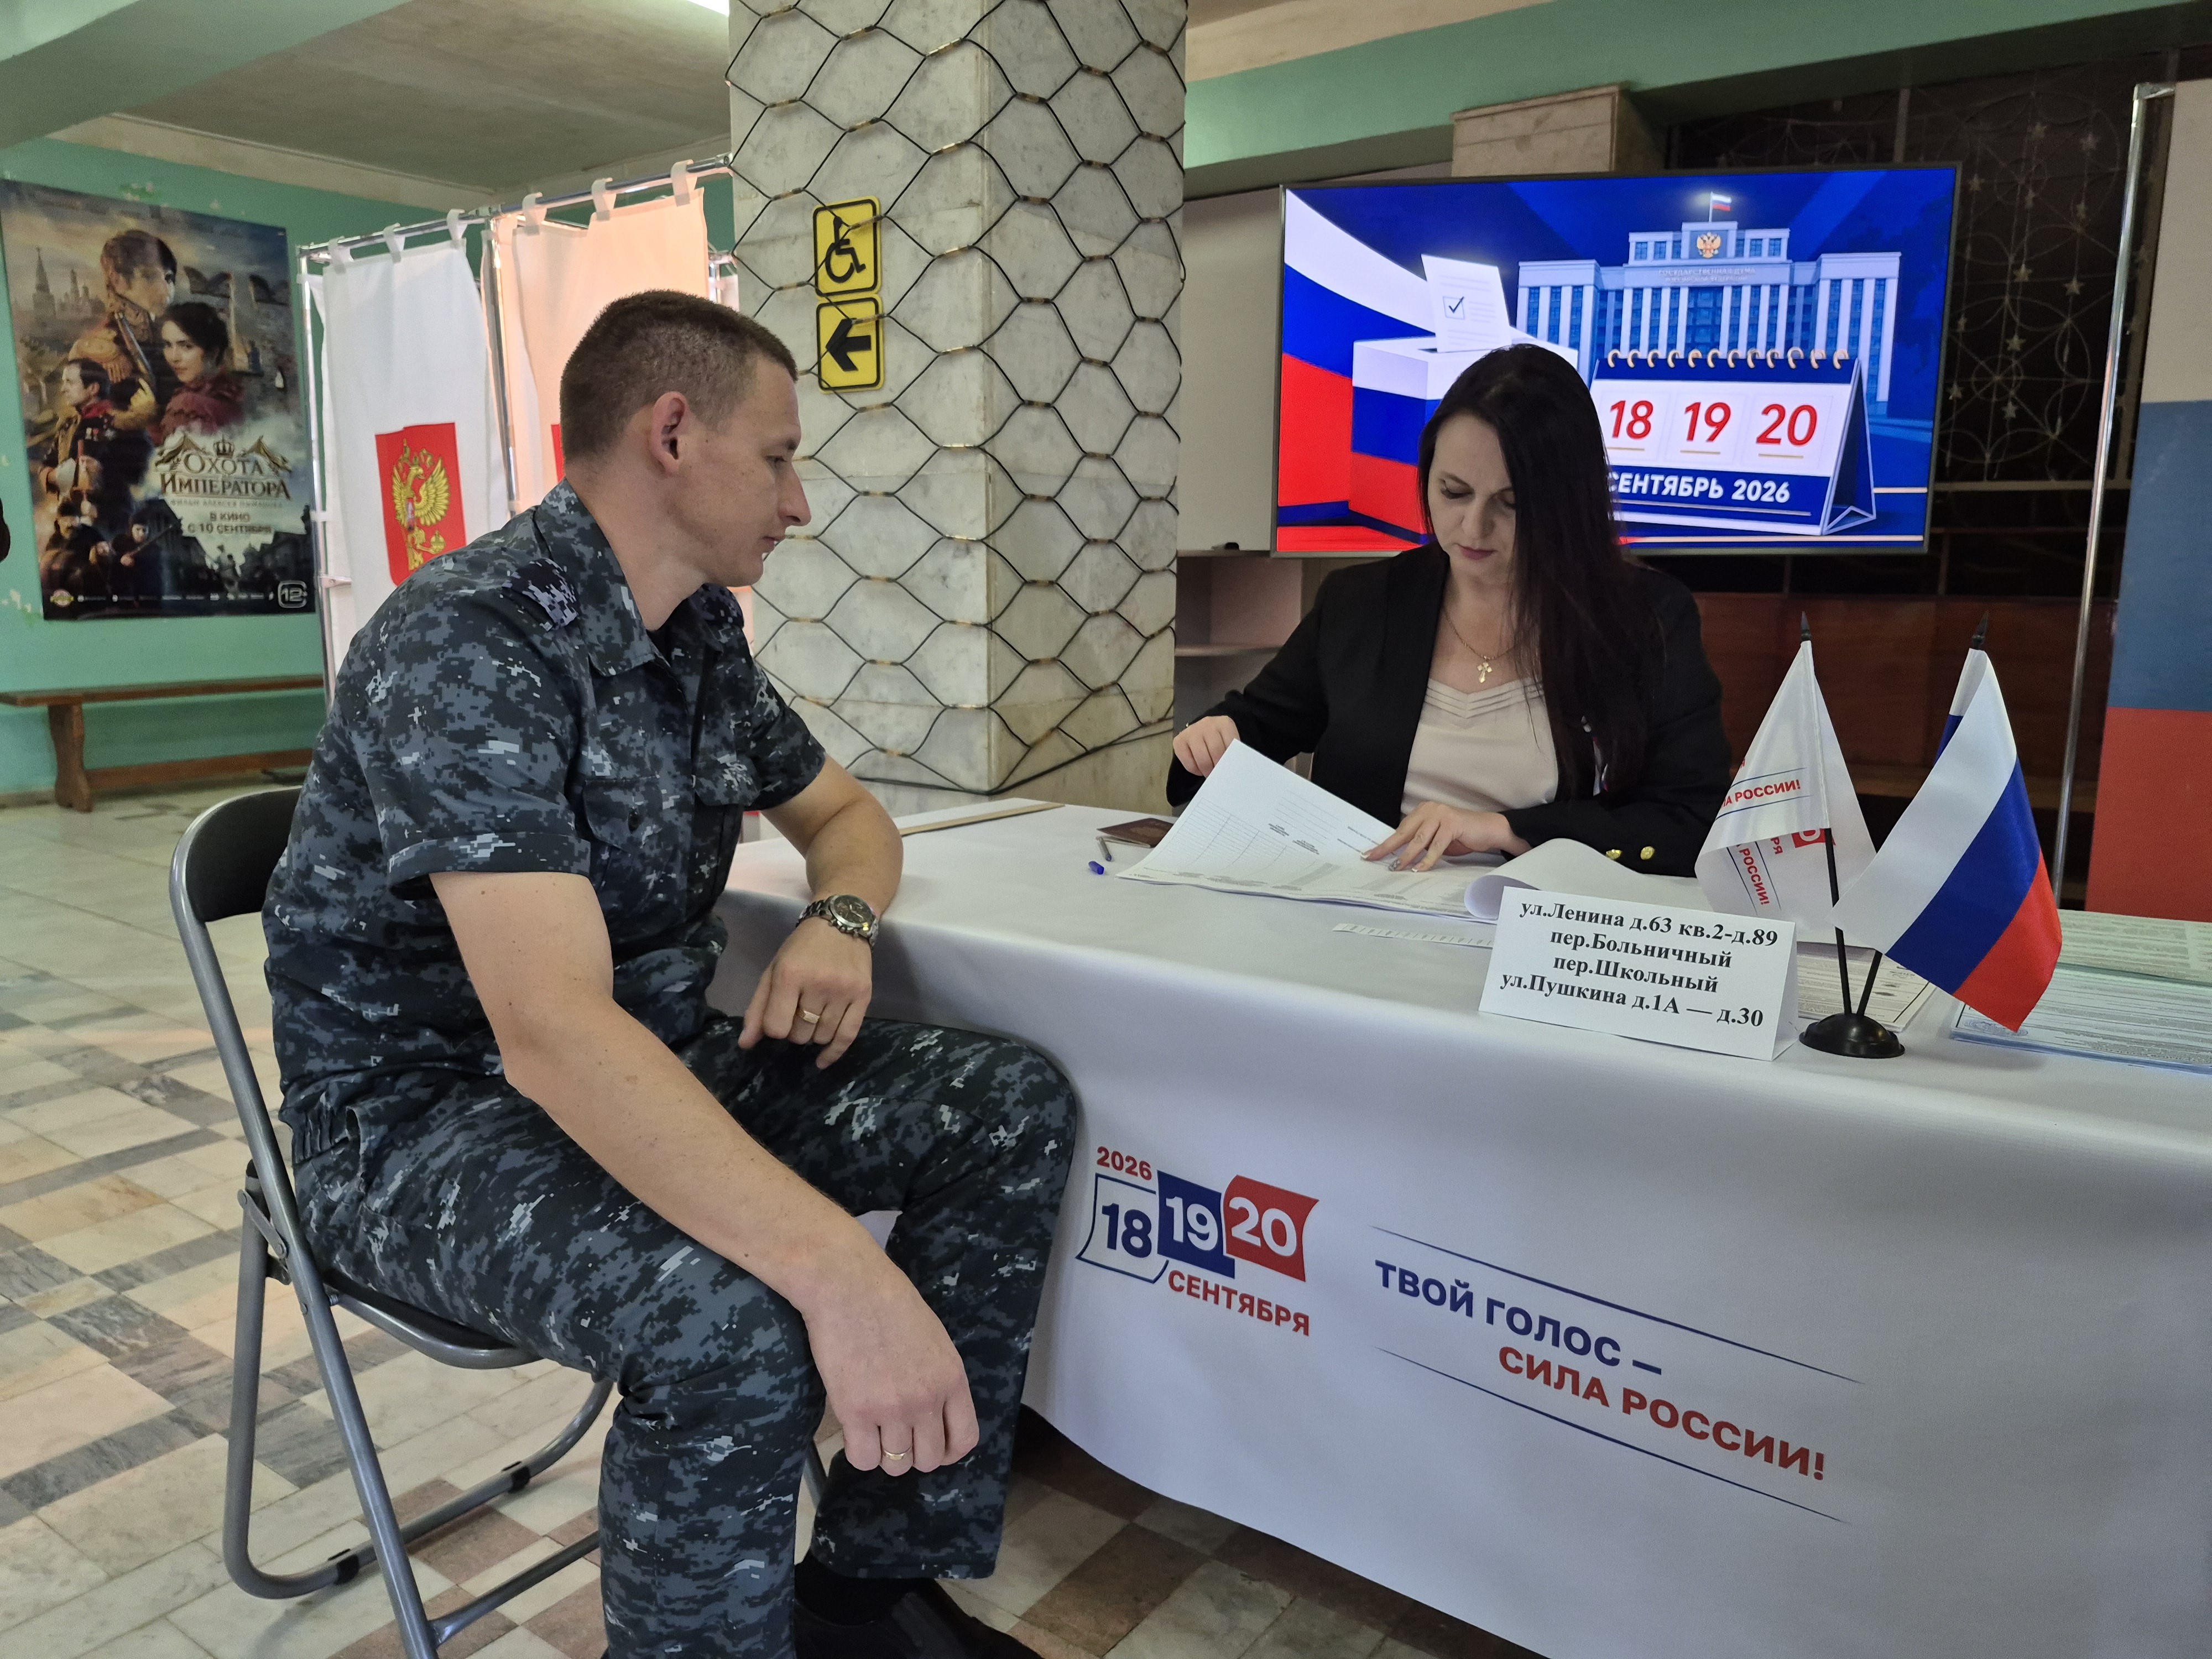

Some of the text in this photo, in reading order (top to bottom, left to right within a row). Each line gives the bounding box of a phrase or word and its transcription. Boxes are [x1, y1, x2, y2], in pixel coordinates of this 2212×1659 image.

[1610, 400, 1818, 447] 18 19 20
[184, 453, 264, 476] ОХОТА
[160, 473, 293, 501] ИМПЕРАТОРА
[1731, 478, 1791, 503] 2026
[200, 523, 214, 534] 10
[210, 512, 251, 522] В КИНО
[1734, 779, 1801, 802] РОССИИ!
[1739, 848, 1770, 905] РОССИИ!
[1519, 902, 1778, 947] ул.Ленина д.63 кв.2-д.89
[1550, 930, 1733, 968] пер.Больничный
[1553, 957, 1719, 993] пер.Школьный
[1500, 973, 1627, 1005] ул.Пушкина
[1632, 994, 1680, 1015] д.1А
[1717, 1008, 1764, 1027] д.30
[1096, 1145, 1152, 1181] 2026
[1102, 1196, 1297, 1258] 18 19 20
[1168, 1270, 1310, 1337] СЕНТЯБРЯ
[1375, 1259, 1474, 1318] ТВОЙ
[1486, 1296, 1622, 1368] ГОЛОС
[1498, 1345, 1825, 1481] СИЛА РОССИИ!
